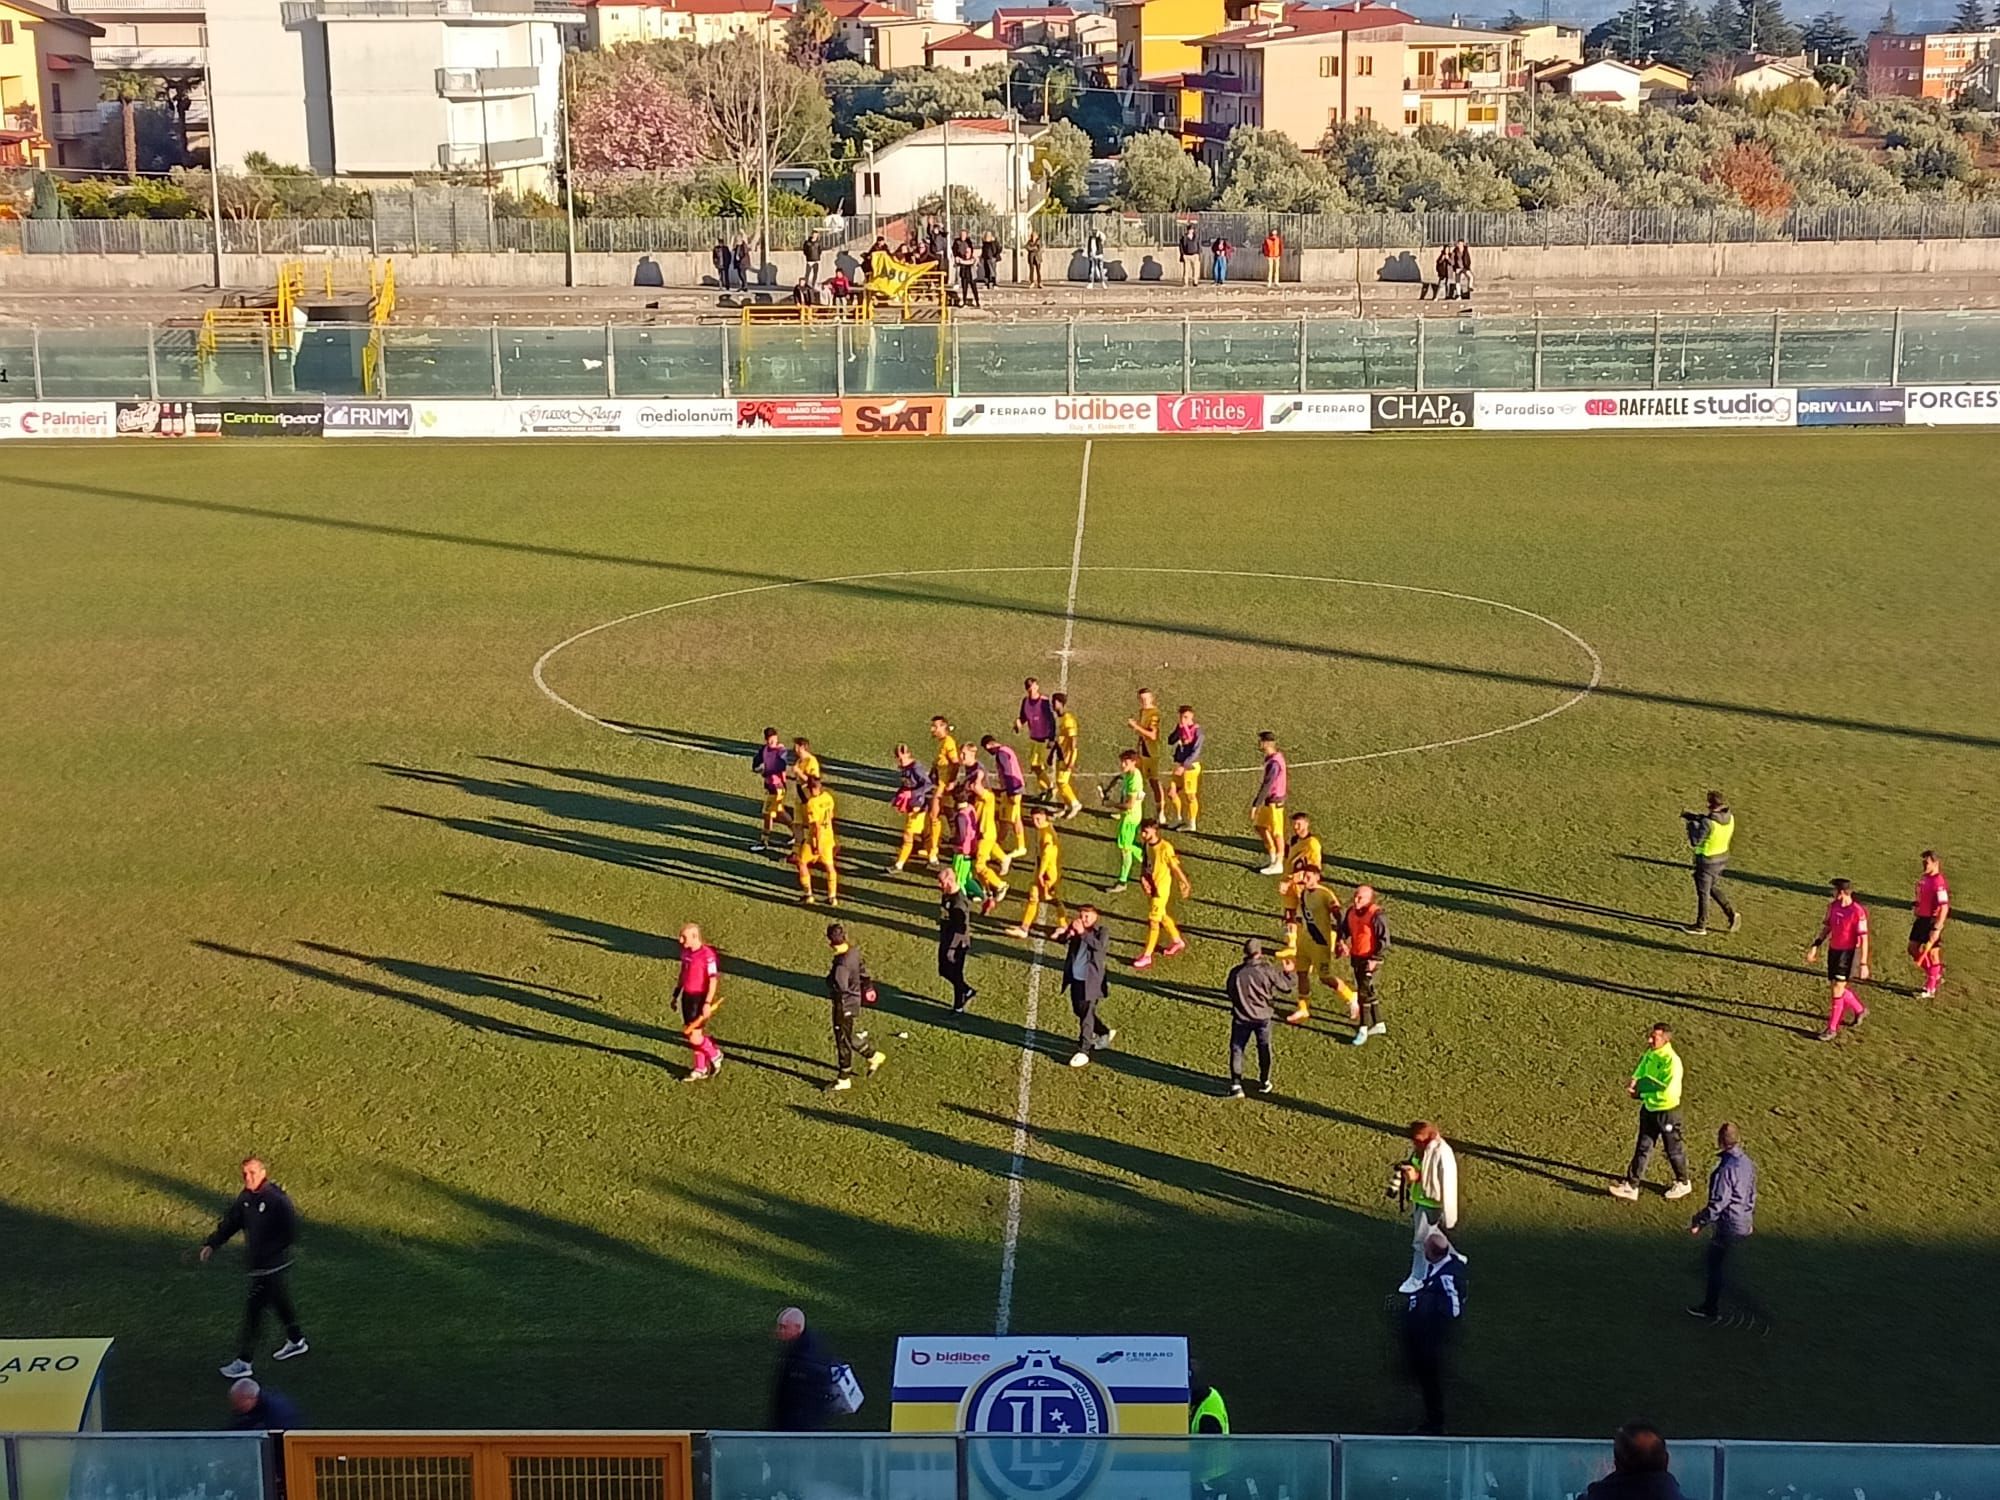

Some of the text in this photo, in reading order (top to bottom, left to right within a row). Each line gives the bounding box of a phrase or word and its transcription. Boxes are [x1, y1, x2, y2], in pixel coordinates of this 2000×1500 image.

[1619, 398, 1689, 415] RAFFAELE
[1798, 401, 1874, 413] DRIVALIA
[1907, 391, 2000, 409] FORGES
[350, 403, 409, 425] FRIMM
[640, 408, 733, 422] mediolanum
[990, 407, 1047, 416] FERRARO
[1055, 398, 1151, 420] bidibee
[1190, 398, 1246, 420] Fides
[1307, 404, 1366, 413] FERRARO
[1495, 403, 1555, 415] Paradiso
[41, 411, 108, 425] Palmieri
[223, 412, 320, 428] Centroriparo
[936, 1352, 991, 1361] bidibee
